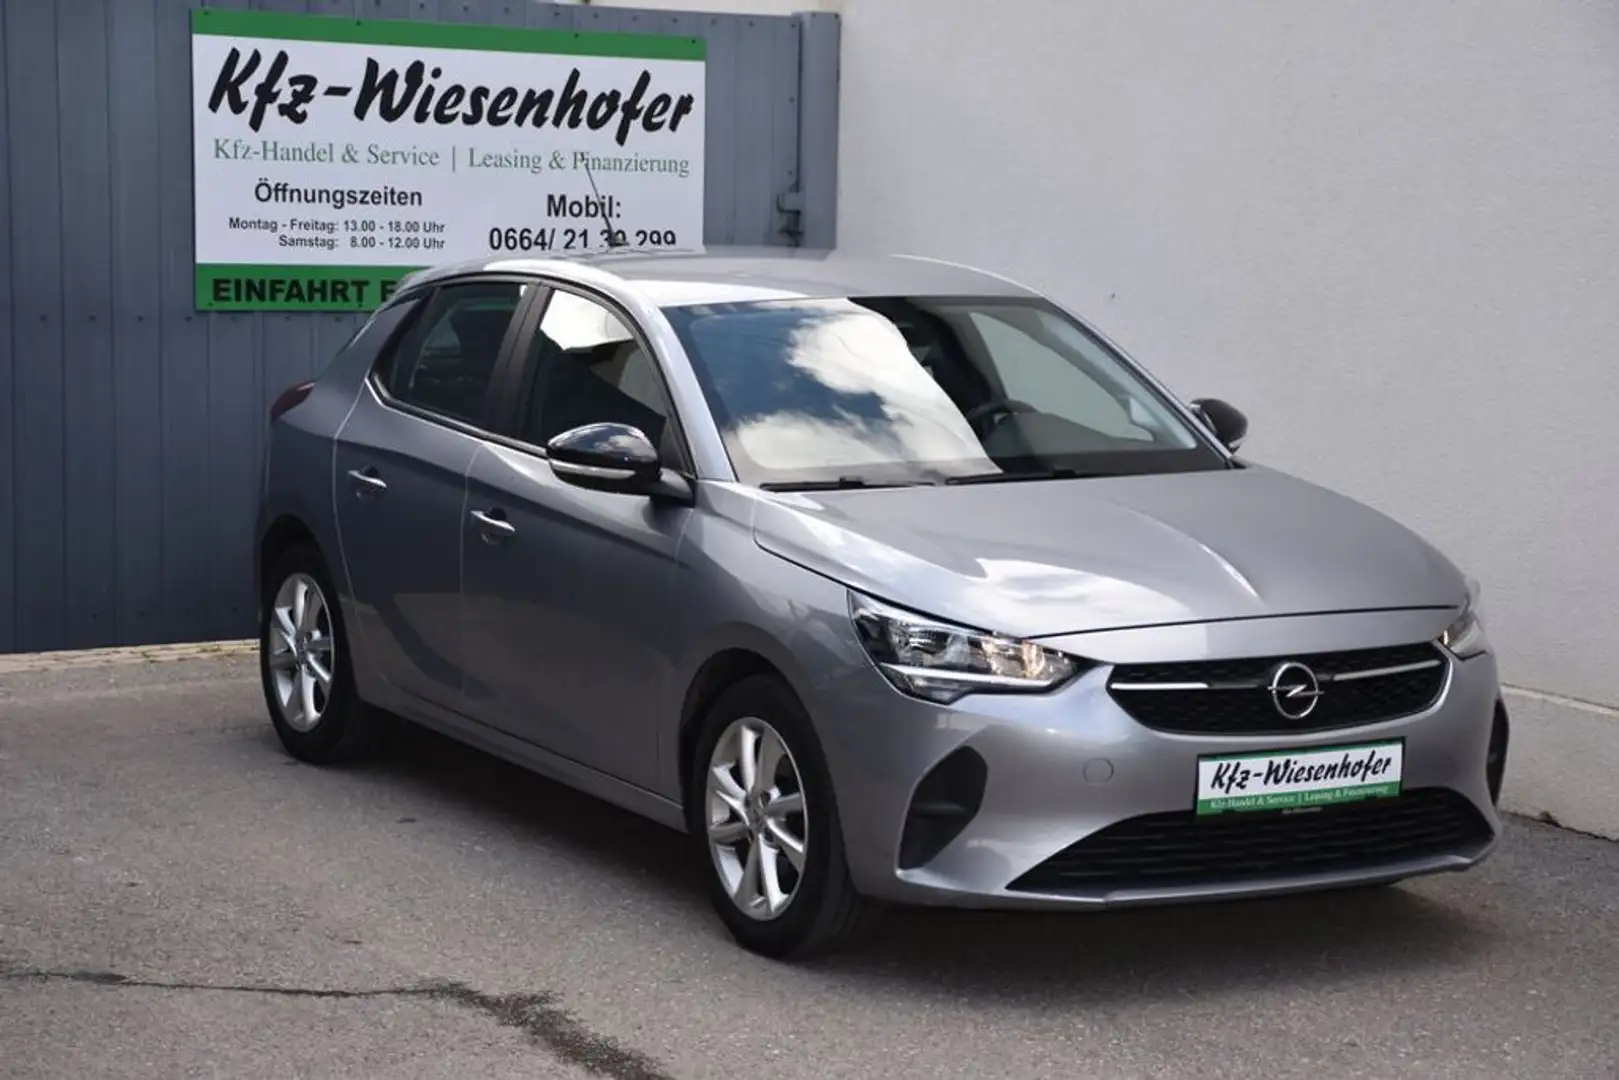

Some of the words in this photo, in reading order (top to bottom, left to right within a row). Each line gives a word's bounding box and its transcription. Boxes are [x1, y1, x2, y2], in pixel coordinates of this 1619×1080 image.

[207, 47, 695, 147] Kfz-Wiesenhofer
[213, 138, 334, 164] Kfz-Handel
[341, 143, 359, 164] &
[367, 144, 441, 166] Service
[468, 147, 542, 174] Leasing
[548, 150, 565, 171] &
[572, 151, 690, 177] Finanzierung
[254, 177, 423, 210] Öffnungszeiten
[547, 194, 622, 219] Mobil:
[228, 216, 278, 232] Montag
[290, 218, 339, 233] Freitag:
[343, 219, 376, 232] 13.00
[388, 220, 420, 233] 18.00
[423, 221, 446, 233] Uhr
[278, 235, 339, 249] Samstag:
[350, 236, 376, 248] 8.00
[388, 236, 420, 249] 12.00
[423, 237, 446, 249] Uhr
[489, 227, 556, 251] 0664/
[563, 228, 589, 250] 21
[212, 278, 370, 303] EINFAHRT
[1210, 749, 1392, 794] Kfz-Wiesenhofer
